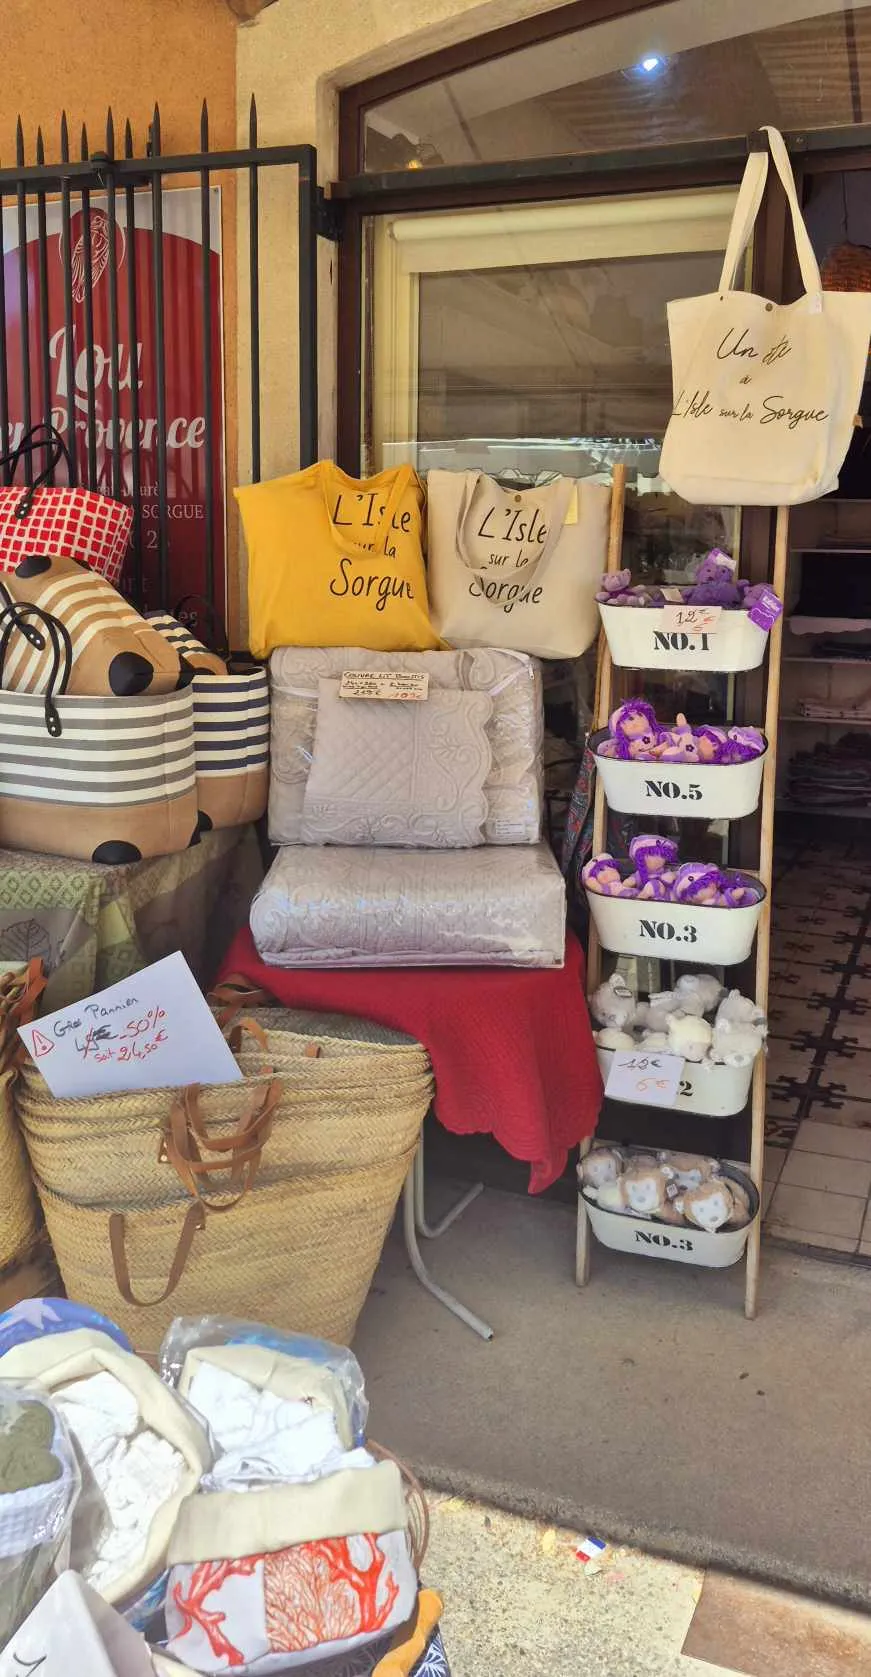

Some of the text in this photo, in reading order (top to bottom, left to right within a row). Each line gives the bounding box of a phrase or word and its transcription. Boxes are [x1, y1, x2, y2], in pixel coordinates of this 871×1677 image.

[716, 328, 759, 360] Un
[672, 390, 713, 419] L'Isle
[760, 395, 829, 430] Sorgue
[478, 507, 547, 544] L'Isle
[384, 536, 396, 559] la
[489, 553, 510, 566] sur
[653, 631, 710, 650] NO.1
[645, 780, 703, 801] NO.5
[639, 919, 698, 943] NO.3
[635, 1231, 694, 1251] NO.3
